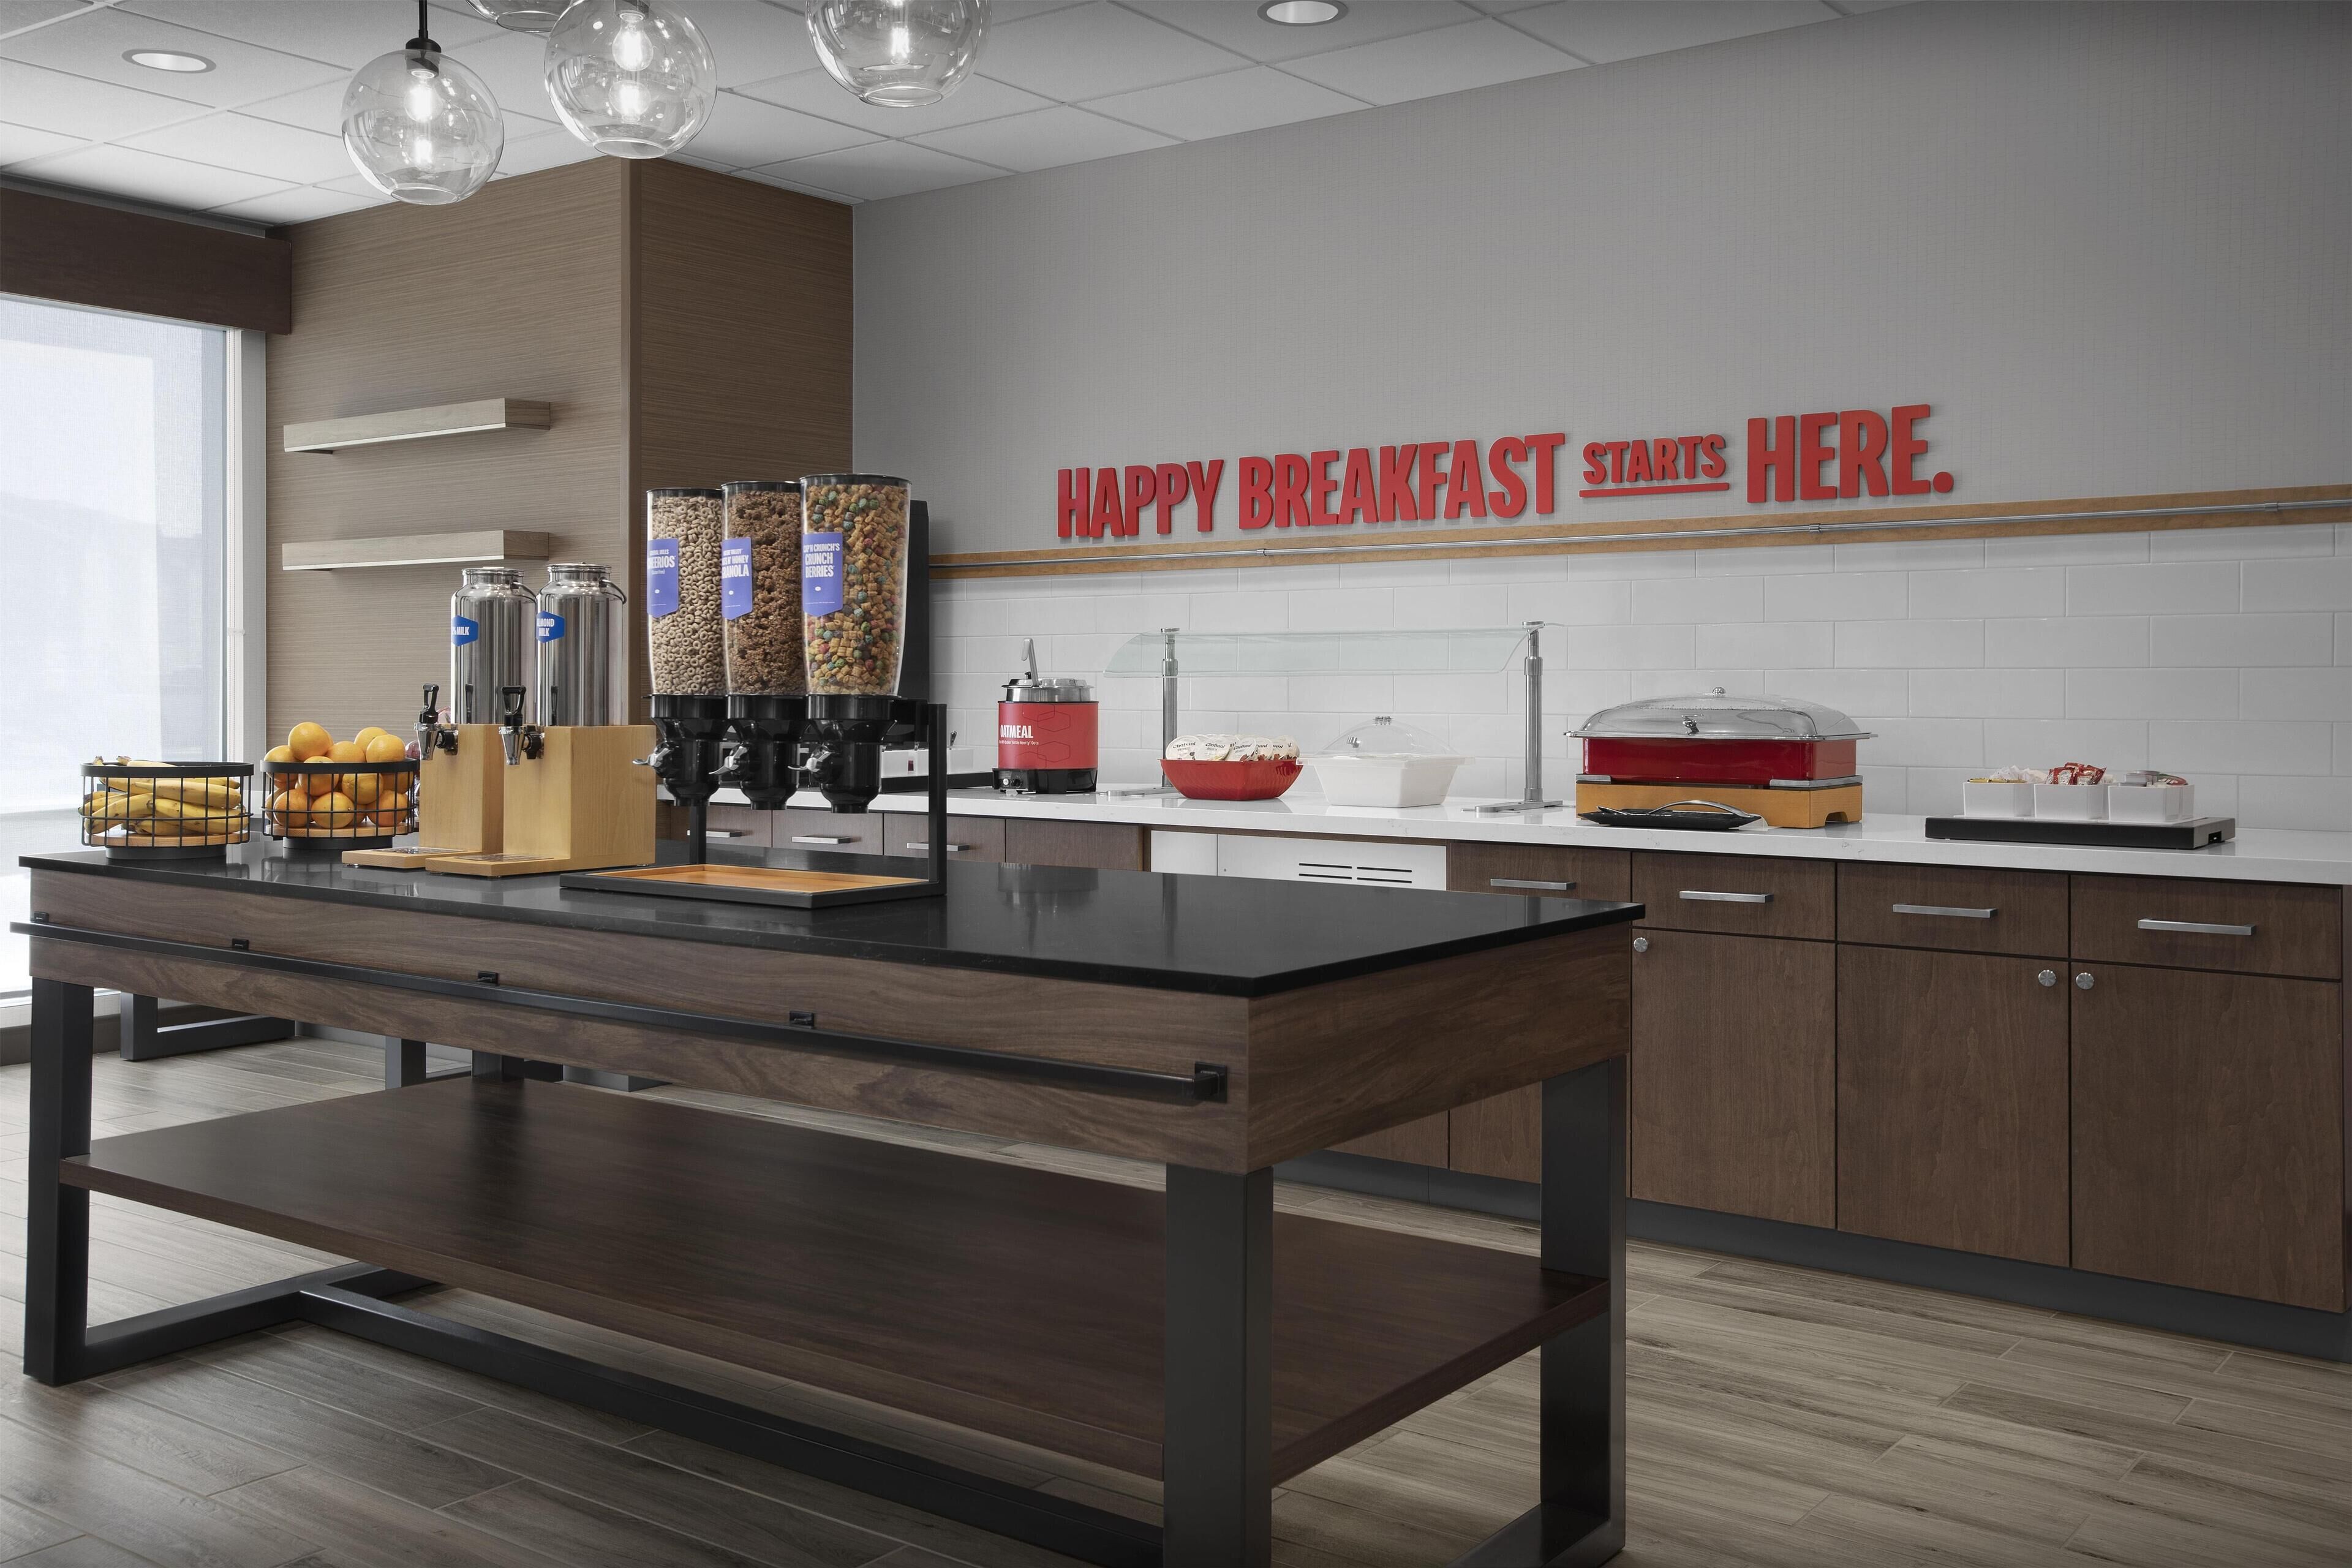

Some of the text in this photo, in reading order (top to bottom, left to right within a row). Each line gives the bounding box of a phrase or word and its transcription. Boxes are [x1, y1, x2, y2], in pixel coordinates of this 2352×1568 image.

[1058, 405, 1954, 538] HAPPY BREAKFAST STARTS HERE.
[813, 543, 840, 552] CRUNCH'S
[648, 556, 675, 568] HEERIOS
[805, 552, 833, 565] CRUNCH
[722, 564, 750, 579] RANOLA
[805, 565, 834, 578] BERRIES
[456, 627, 470, 635] MILK
[1000, 725, 1034, 739] OATMEAL
